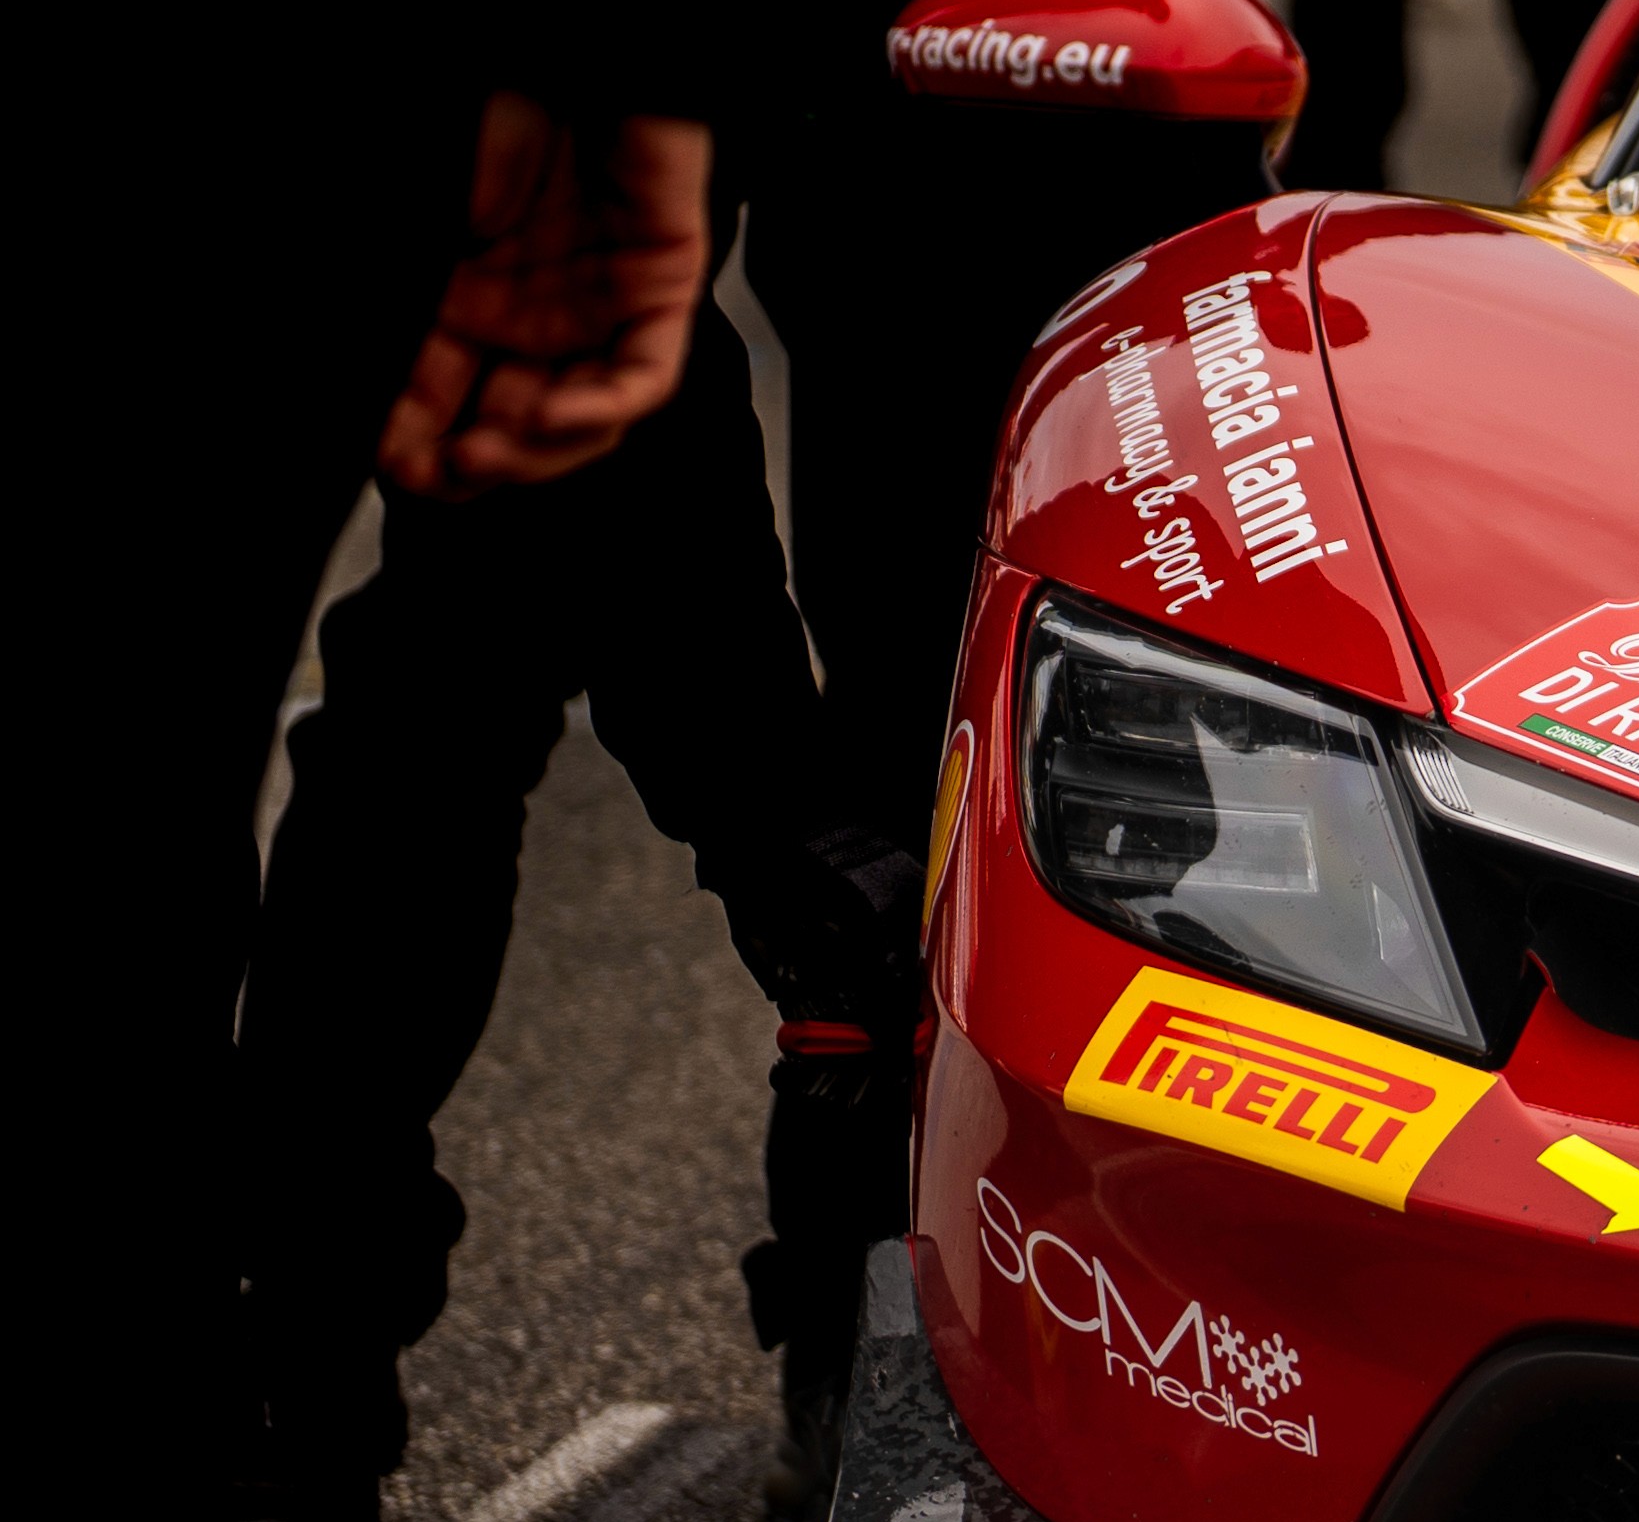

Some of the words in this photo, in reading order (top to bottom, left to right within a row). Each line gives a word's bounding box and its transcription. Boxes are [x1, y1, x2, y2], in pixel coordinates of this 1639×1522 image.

[1078, 324, 1174, 495] e-pharmacy
[1181, 270, 1299, 451] farmacia
[1132, 473, 1199, 519] &
[1222, 434, 1349, 583] ianni
[1120, 516, 1225, 616] sport
[1517, 666, 1620, 713] DI
[1544, 725, 1607, 754] CONSERVE
[1099, 999, 1438, 1166] PIRELLI
[976, 1175, 1213, 1390] SCM
[1104, 1347, 1319, 1459] medical
